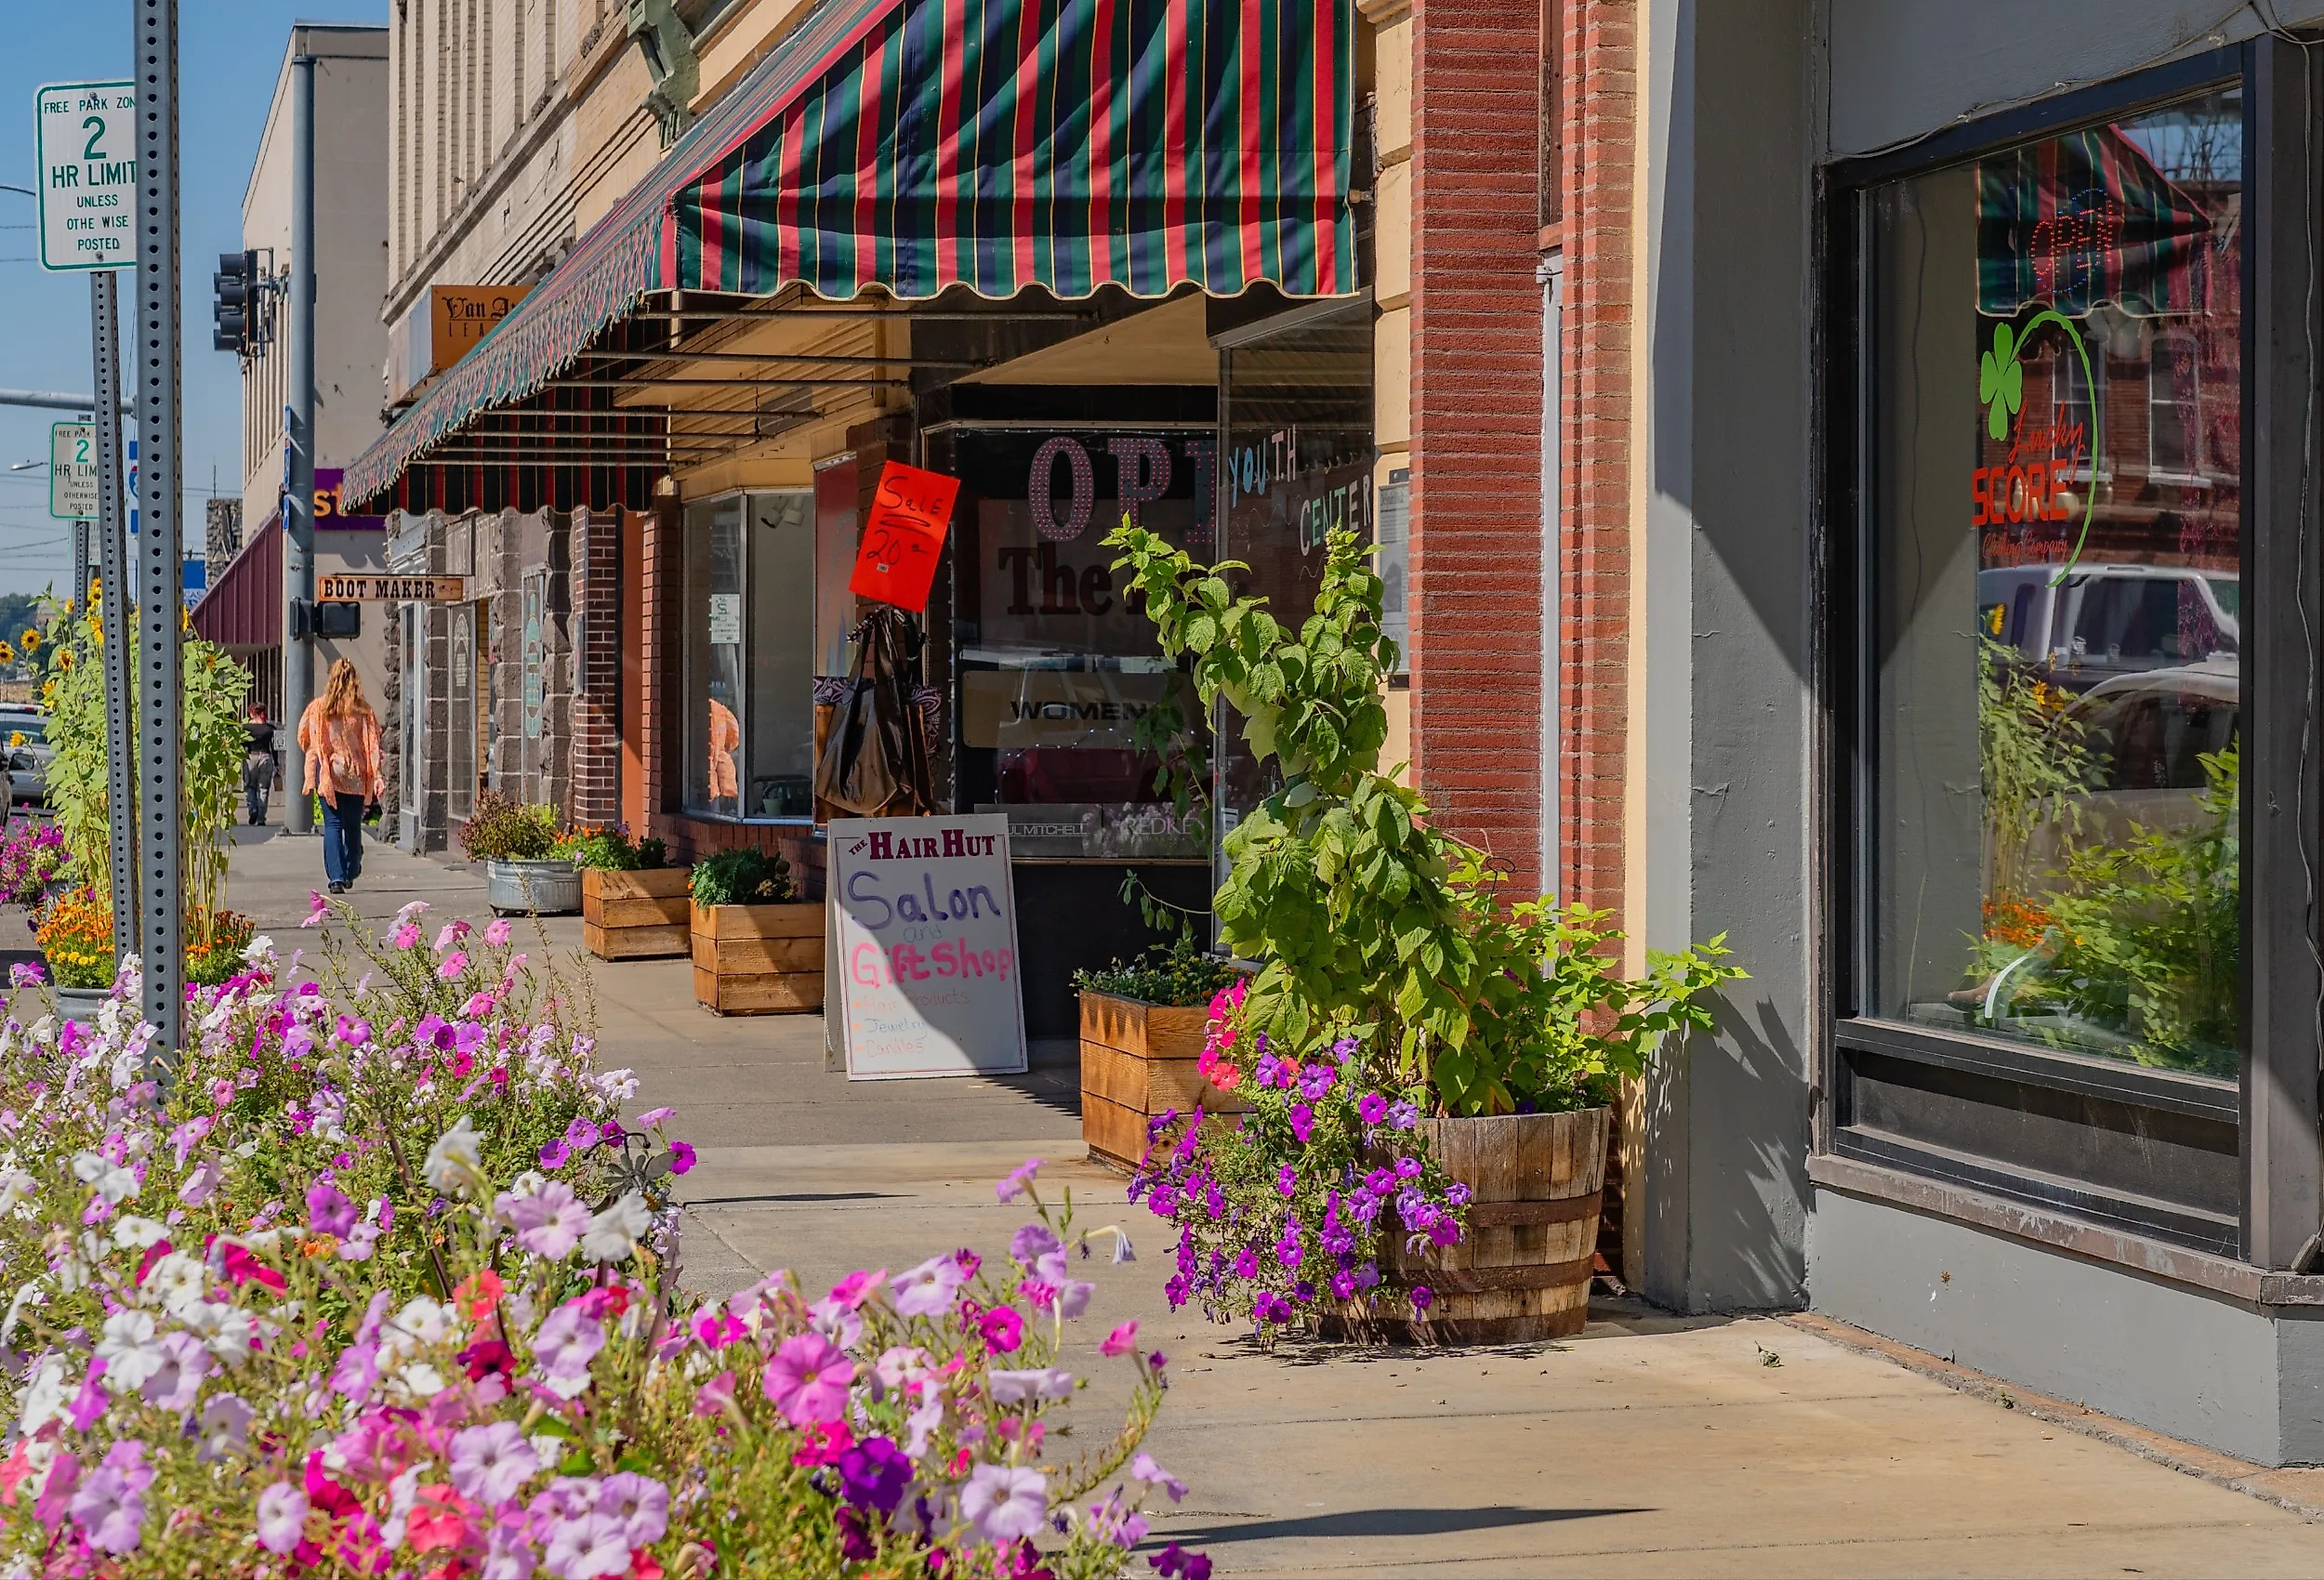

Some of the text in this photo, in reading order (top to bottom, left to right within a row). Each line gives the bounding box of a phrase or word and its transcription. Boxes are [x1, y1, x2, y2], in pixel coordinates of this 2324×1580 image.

[45, 96, 135, 114] FREE PARK ZON
[82, 116, 107, 161] 2
[52, 165, 79, 189] HR
[76, 193, 118, 208] UNLESS
[78, 237, 120, 252] POSTED
[2030, 204, 2112, 275] OPEN
[442, 296, 518, 319] Van A
[449, 322, 484, 338] LEA
[75, 439, 90, 464] 2
[2008, 399, 2086, 485] Lucky
[54, 464, 98, 477] HR LIM
[1228, 424, 1297, 508] YOUTH
[1972, 458, 2068, 526] SCORE
[1300, 474, 1372, 557] CENTER
[1983, 533, 2068, 568] Clothing Company
[324, 579, 436, 599] BOOT MAKER
[997, 542, 1114, 616] The
[1010, 701, 1149, 720] WOMEN
[1023, 824, 1089, 835] MITCHELL
[1129, 817, 1205, 836] REDKE
[848, 828, 996, 860] THE HAIR HUT
[847, 870, 1002, 929] Salon
[903, 924, 943, 942] and
[852, 937, 1012, 989] Gift Shop
[863, 1018, 929, 1040] Jewelry
[866, 1039, 925, 1058] Candles
